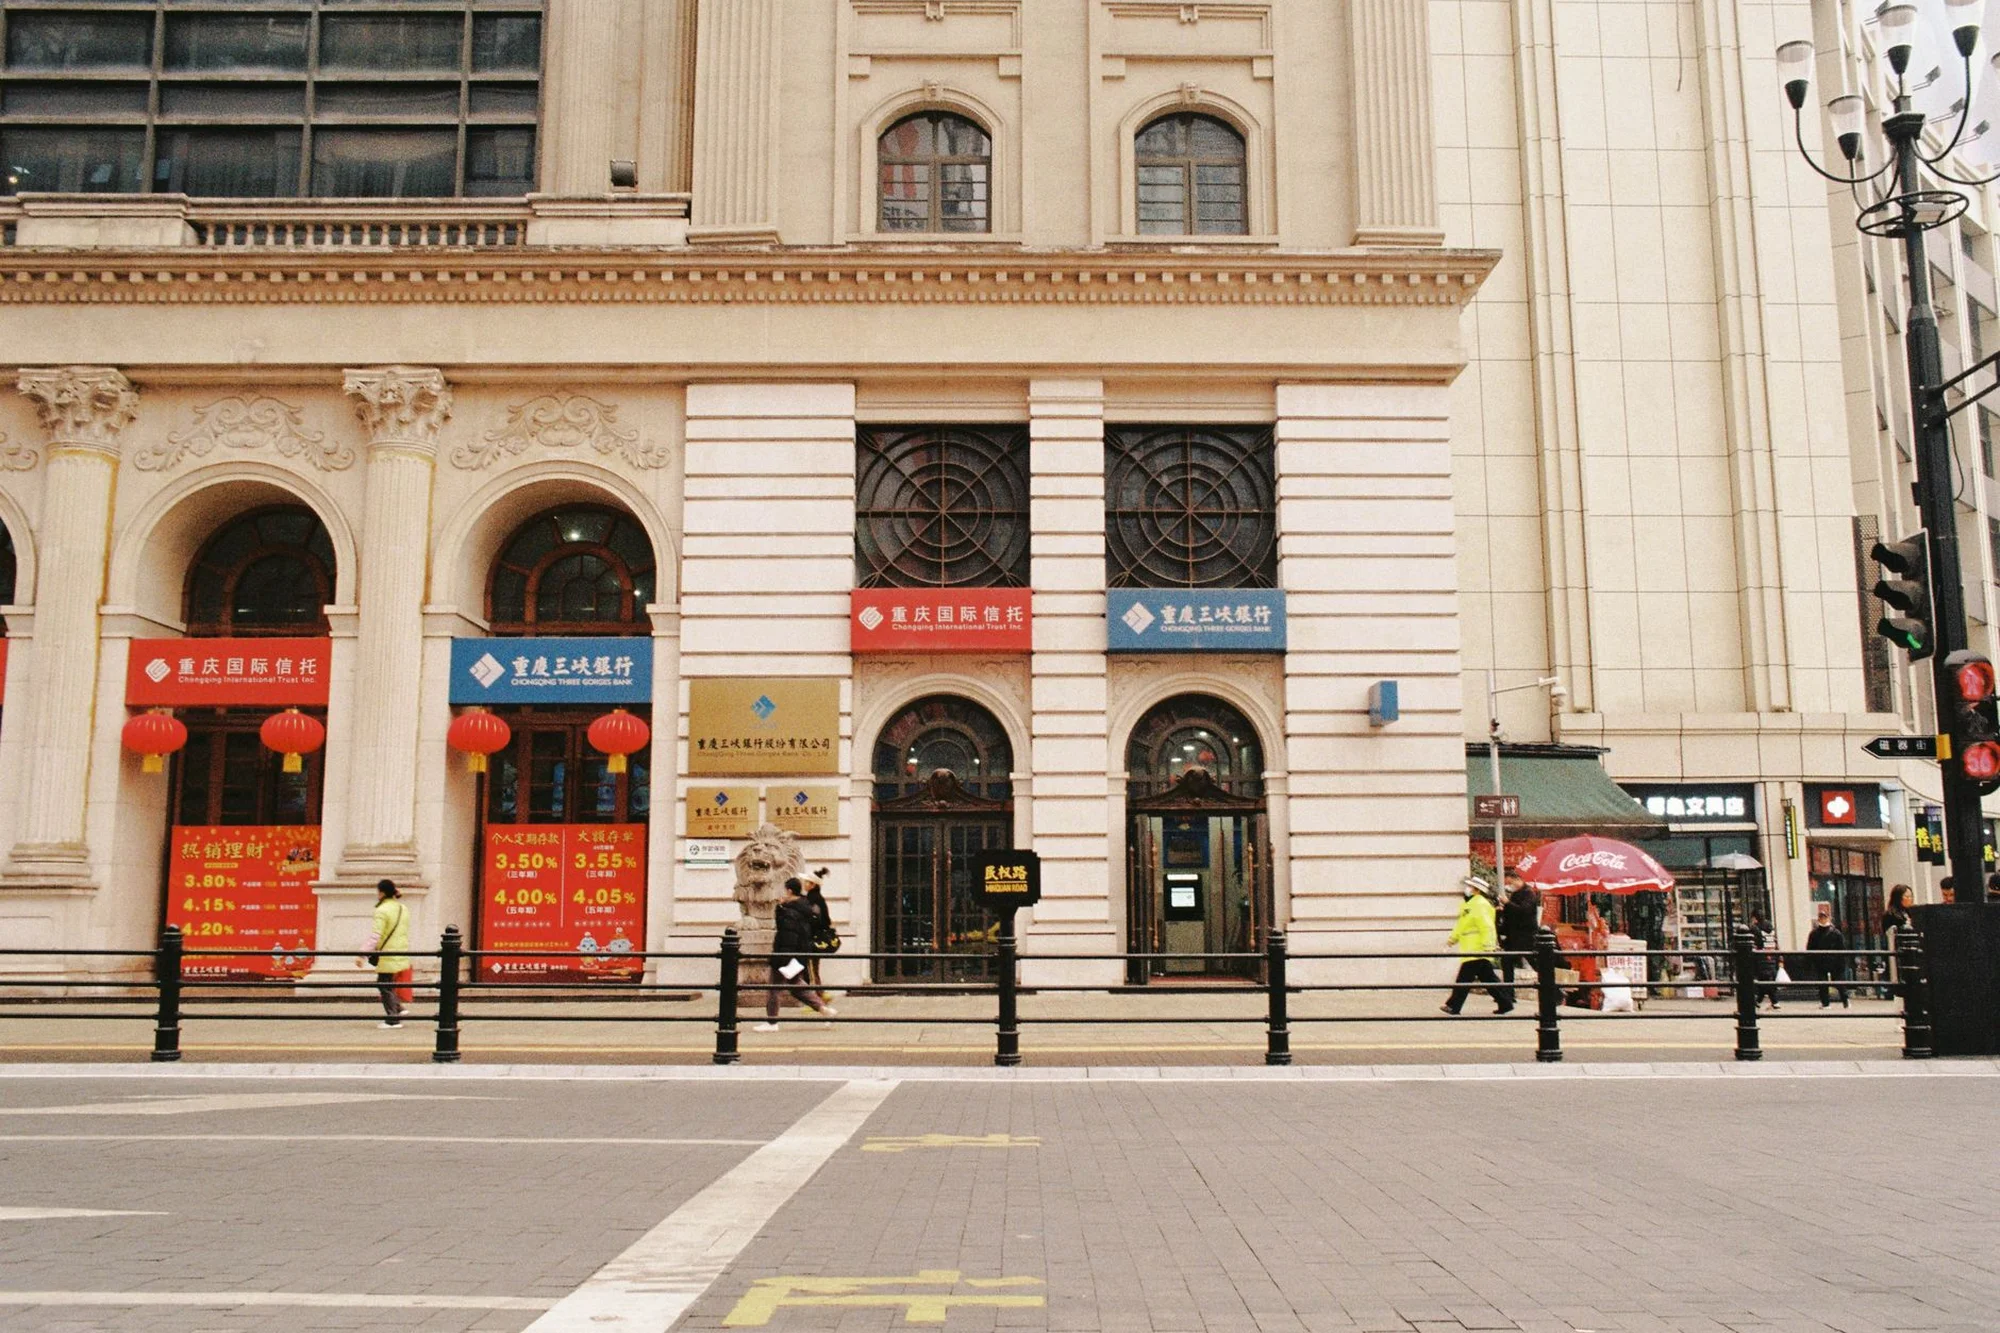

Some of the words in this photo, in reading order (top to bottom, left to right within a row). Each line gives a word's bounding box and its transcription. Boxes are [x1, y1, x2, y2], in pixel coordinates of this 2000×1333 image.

[891, 606, 1023, 622] 重庆国际信托
[892, 623, 934, 632] Chongqing
[1160, 625, 1202, 633] CHONGQING
[178, 658, 317, 675] 重庆国际信托
[178, 676, 222, 684] Chongqing
[224, 676, 276, 684] International
[278, 676, 298, 684] Trust
[511, 678, 557, 686] CHONGQING
[558, 678, 580, 686] THREE
[582, 678, 612, 686] GORGES
[613, 678, 632, 686] BANK
[495, 853, 558, 869] 3.50%
[574, 853, 636, 868] 3.55%
[984, 865, 1028, 880] 民权路
[185, 874, 237, 888] 3.80%
[986, 884, 1012, 892] MINQUAN
[1012, 884, 1028, 892] ROAD
[494, 889, 557, 905] 4.00%
[573, 888, 636, 904] 4.05%
[183, 898, 236, 912] 4.15%
[182, 922, 234, 936] 4.20%
